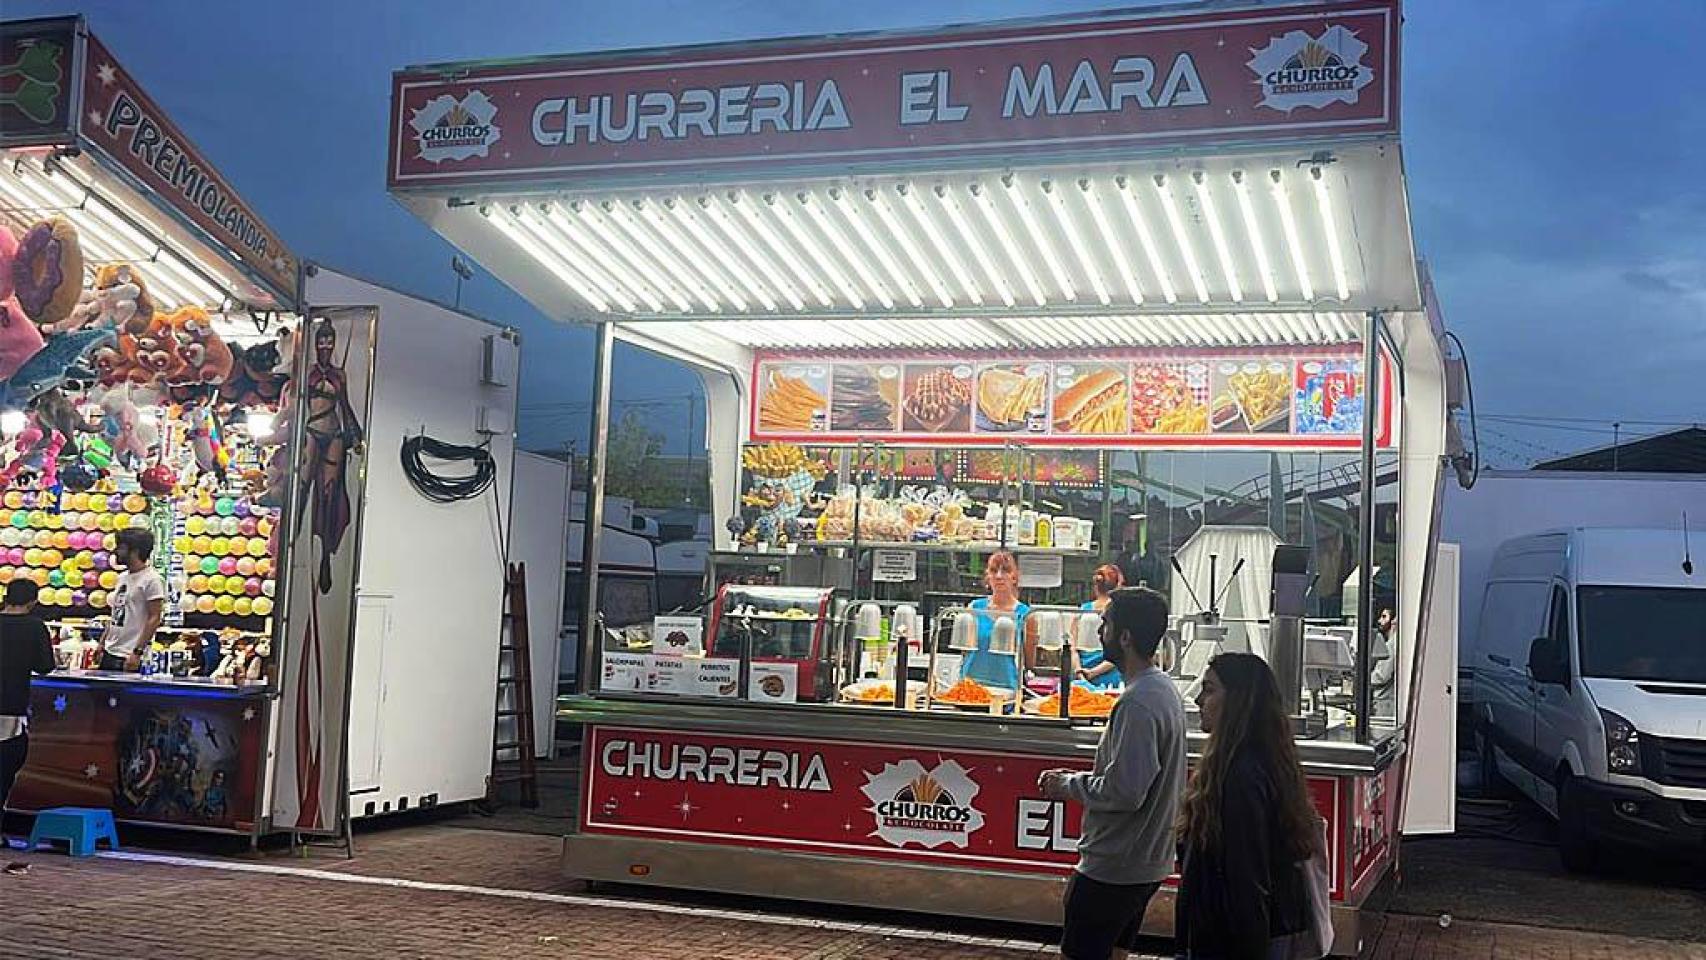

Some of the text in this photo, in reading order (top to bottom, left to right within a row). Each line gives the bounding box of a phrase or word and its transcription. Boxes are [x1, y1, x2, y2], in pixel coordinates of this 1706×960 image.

[531, 51, 1209, 146] CHURRERIA EL MARA
[1266, 65, 1359, 84] CHURROS
[422, 125, 490, 140] CHURROS
[106, 92, 268, 255] PREMIOLANDIA
[602, 740, 1080, 851] CHURRERIA EL
[878, 801, 970, 822] CHURROS
